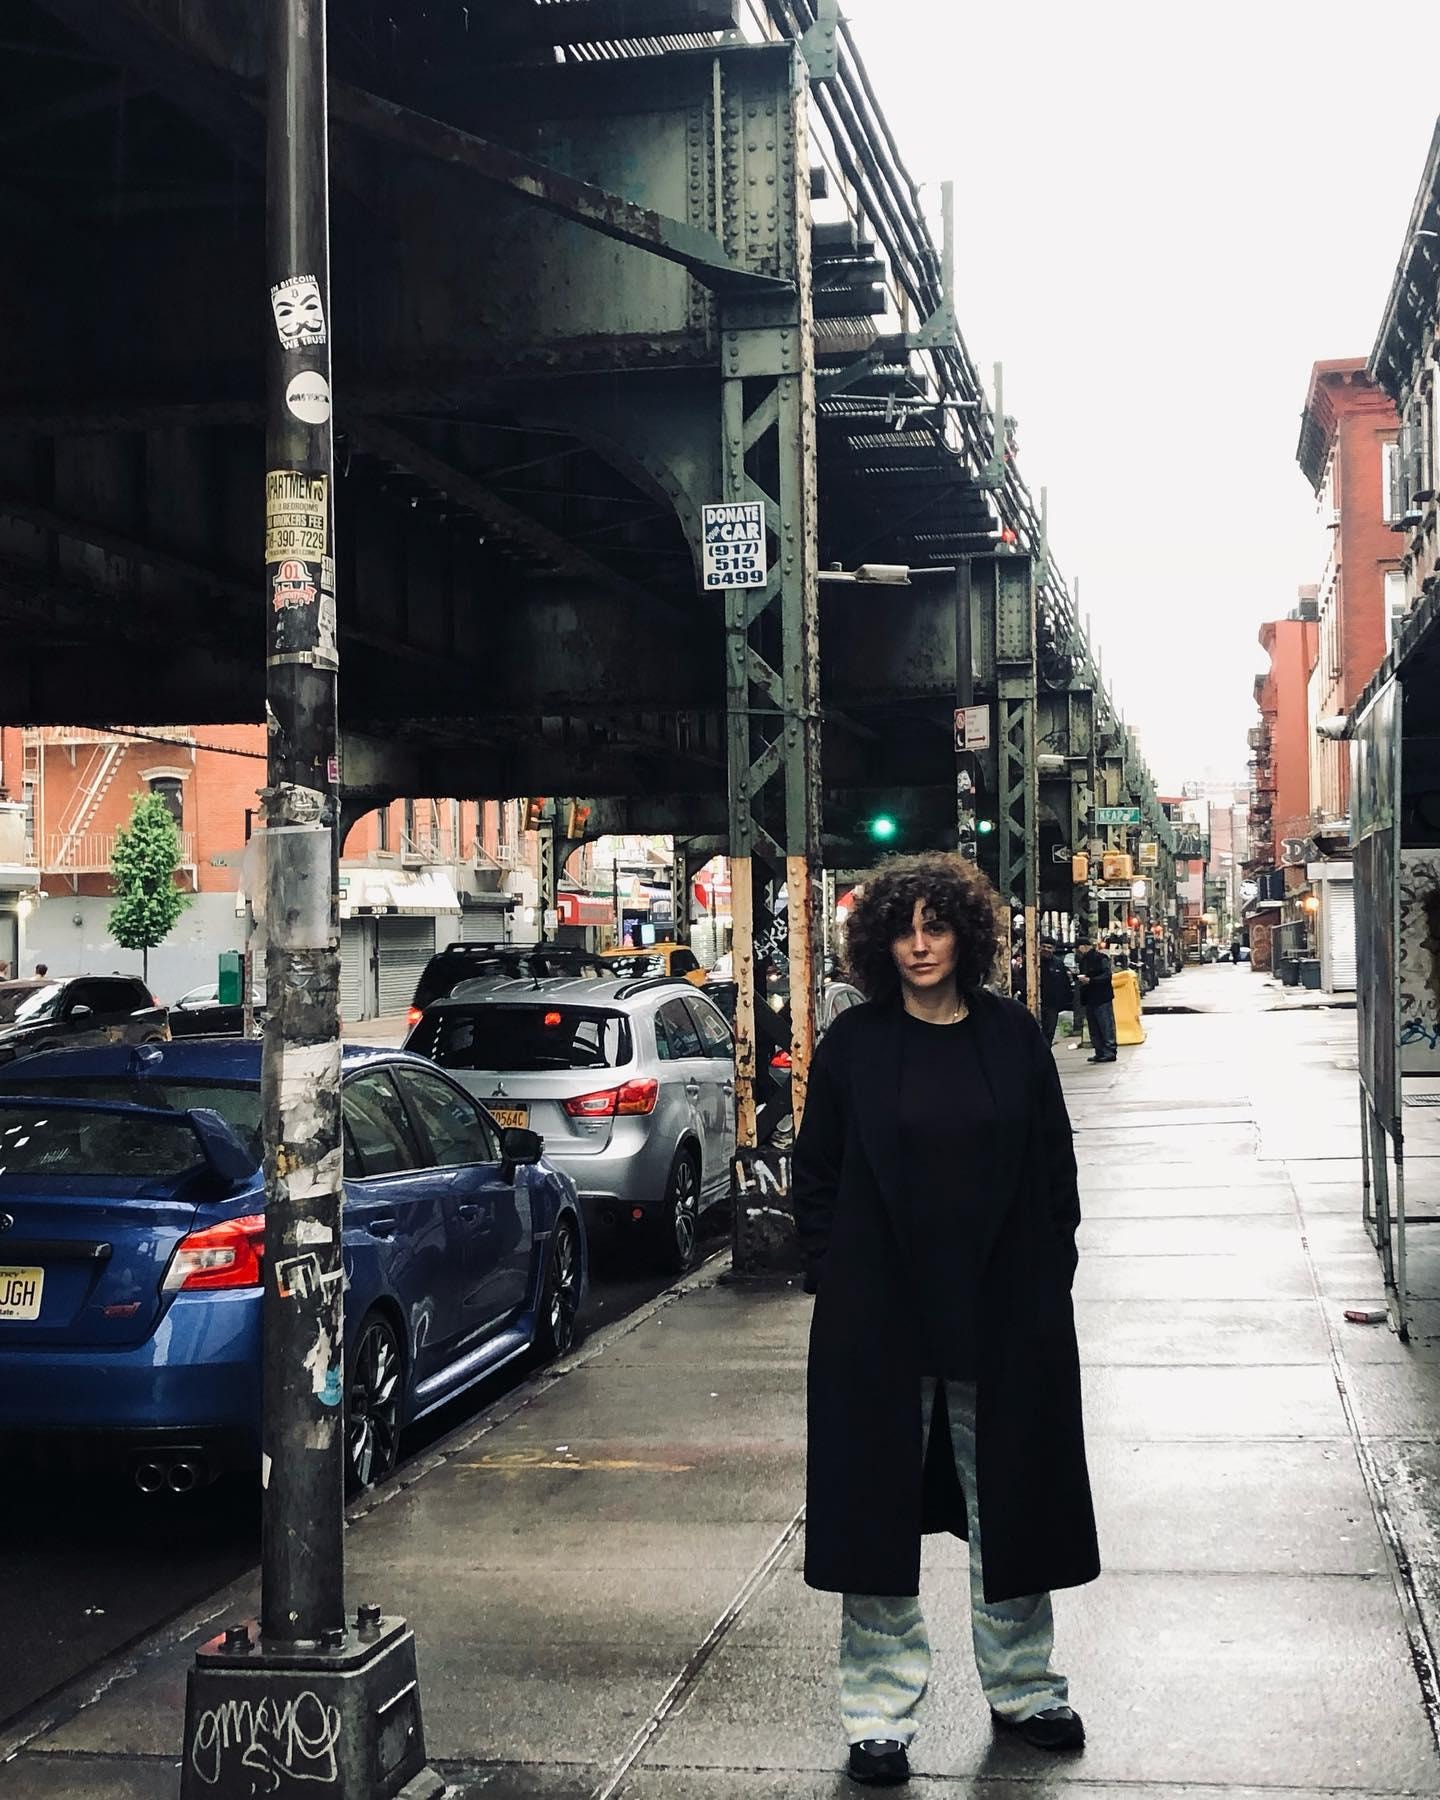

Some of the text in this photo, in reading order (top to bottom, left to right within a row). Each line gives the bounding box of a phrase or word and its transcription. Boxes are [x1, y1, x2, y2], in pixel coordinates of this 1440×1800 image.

[270, 274, 316, 294] IN BITCOIN
[282, 335, 327, 351] WE TRUST
[308, 516, 323, 529] FEE
[706, 506, 759, 524] DONATE
[720, 522, 760, 541] CAR
[708, 542, 759, 557] (917)
[715, 556, 755, 571] 515
[707, 570, 763, 585] 6499
[1099, 810, 1123, 822] KEAP
[490, 1111, 523, 1127] 0564C
[0, 1280, 36, 1306] JGH
